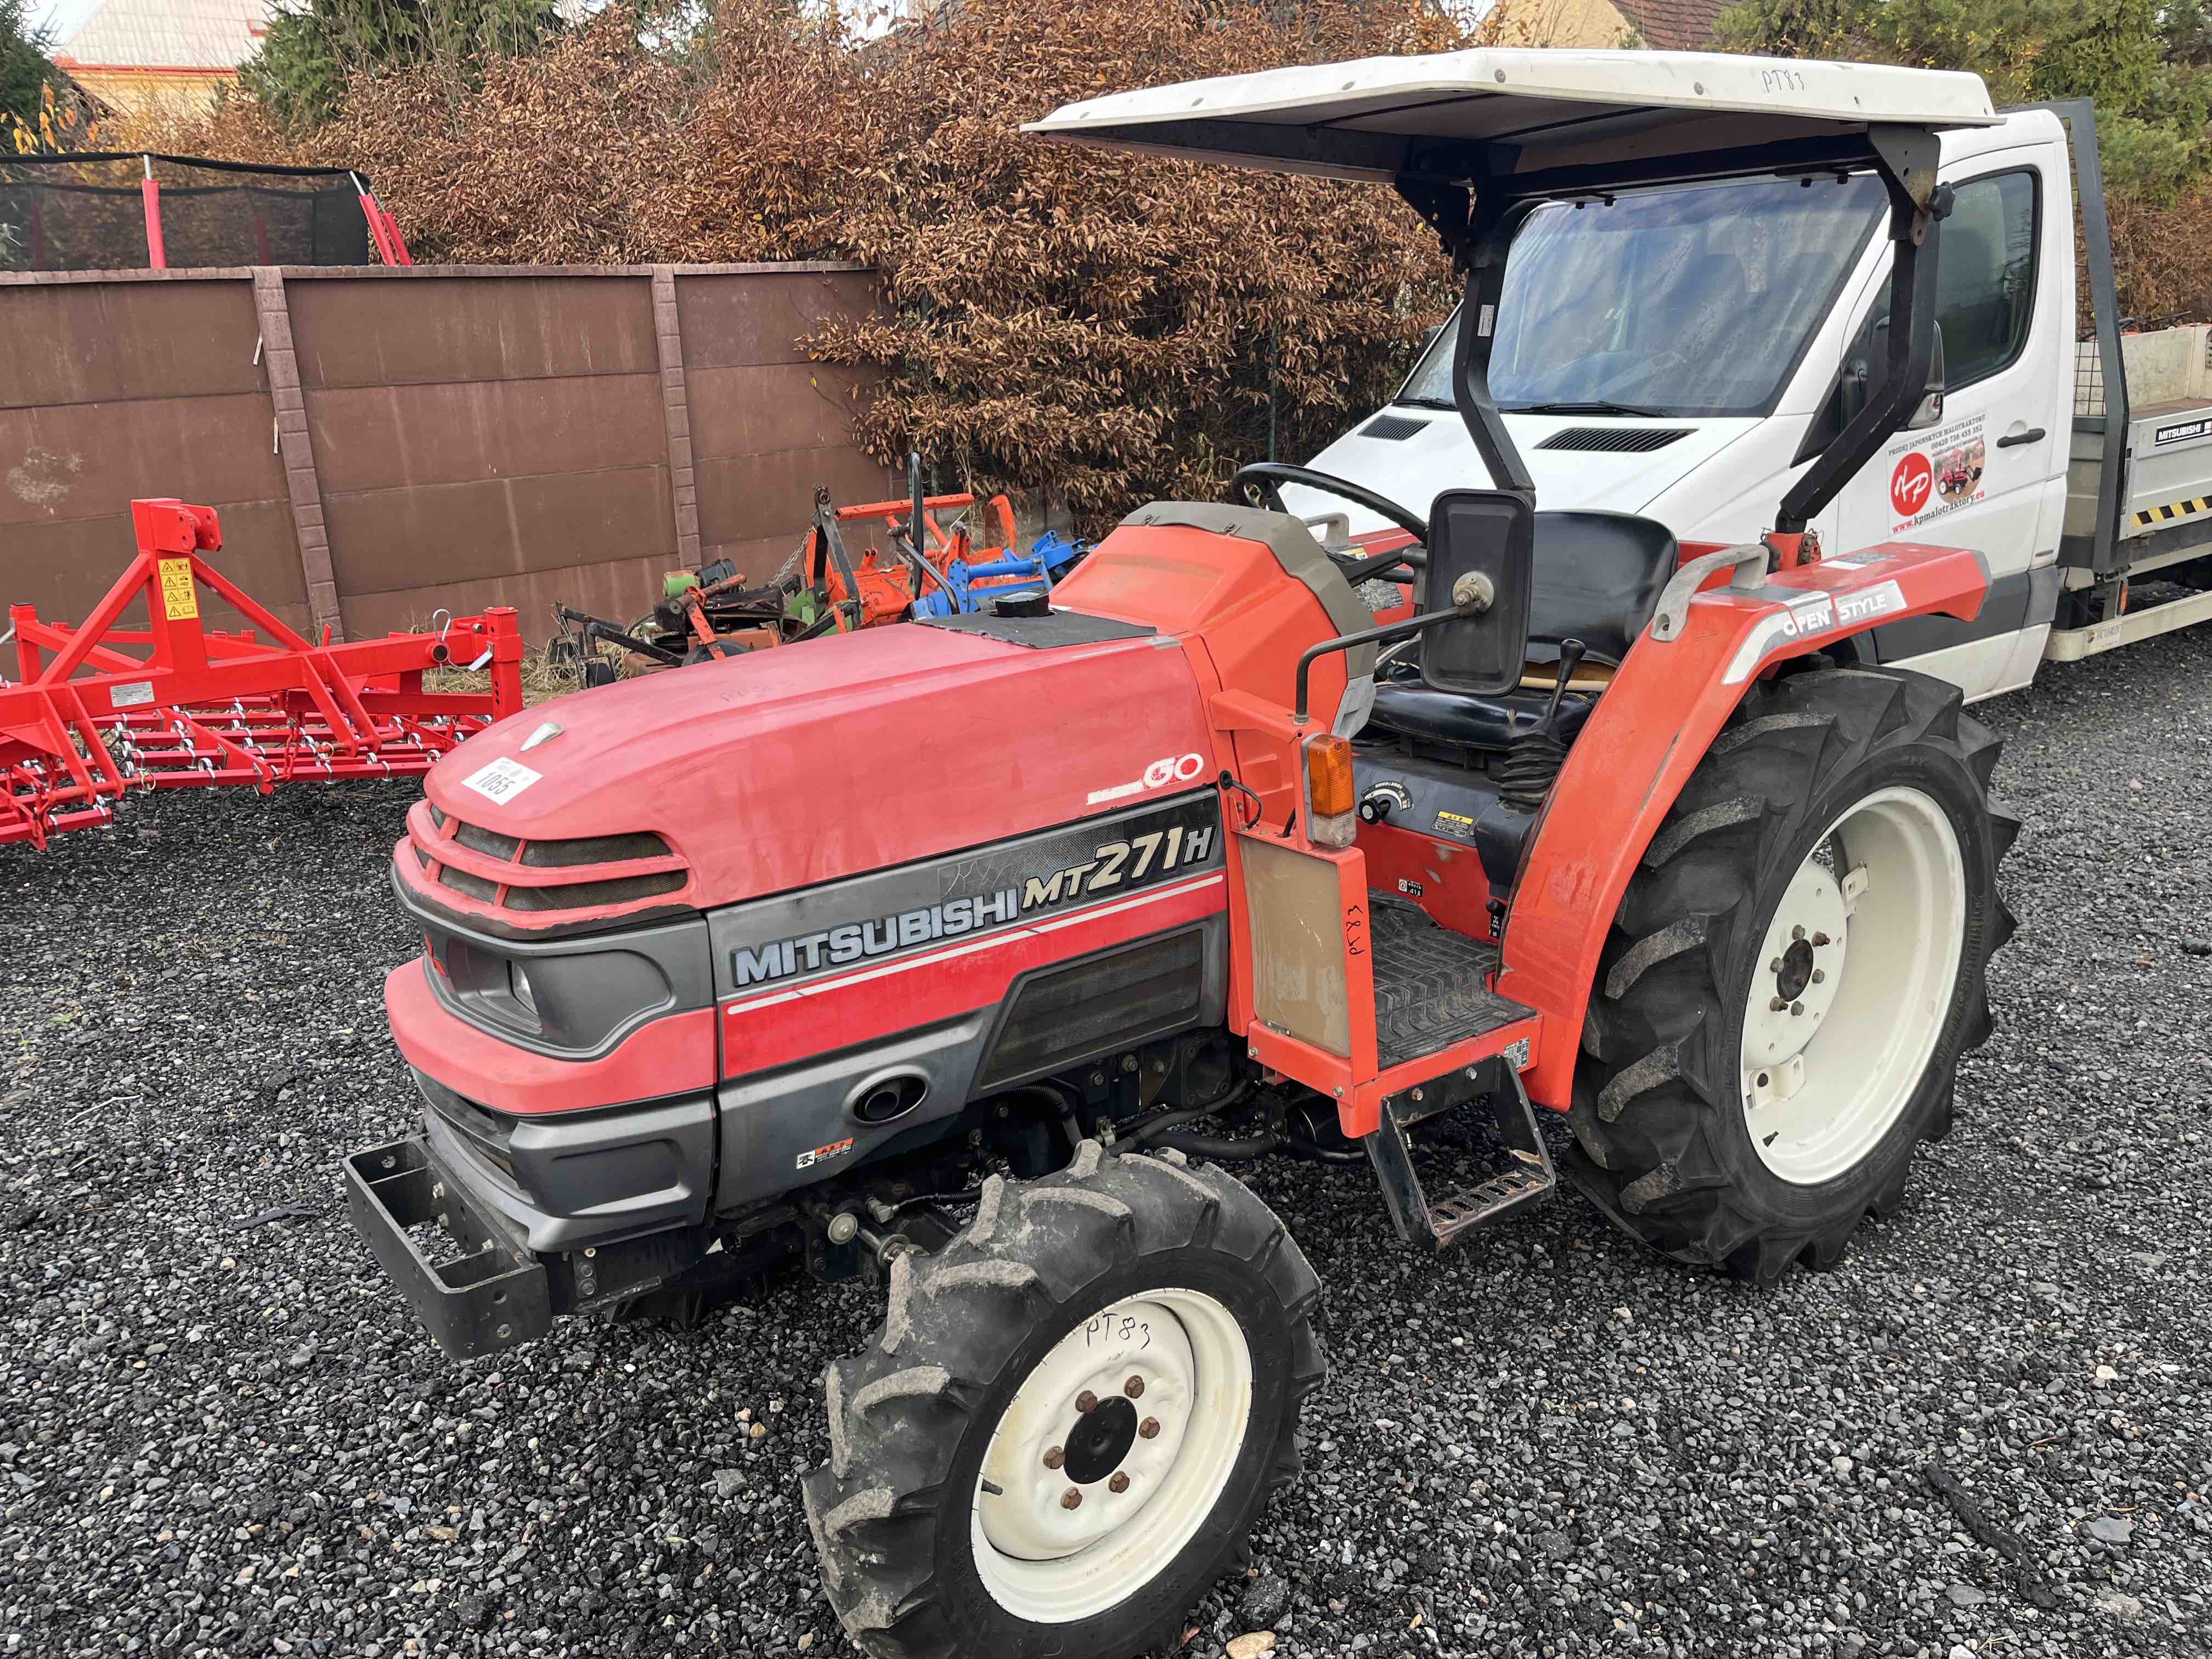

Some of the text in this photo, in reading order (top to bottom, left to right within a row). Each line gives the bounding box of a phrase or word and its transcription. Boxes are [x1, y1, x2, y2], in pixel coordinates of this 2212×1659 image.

[1762, 69, 1805, 93] PT83
[2158, 424, 2201, 441] MITSUBISHI
[1892, 490, 1985, 534] www.kpmalotraktory.eu
[1783, 594, 1887, 636] OPEN STYLE
[476, 772, 516, 795] 1055
[735, 888, 1019, 986] MITSUBISHI
[1086, 1313, 1150, 1350] PT83
